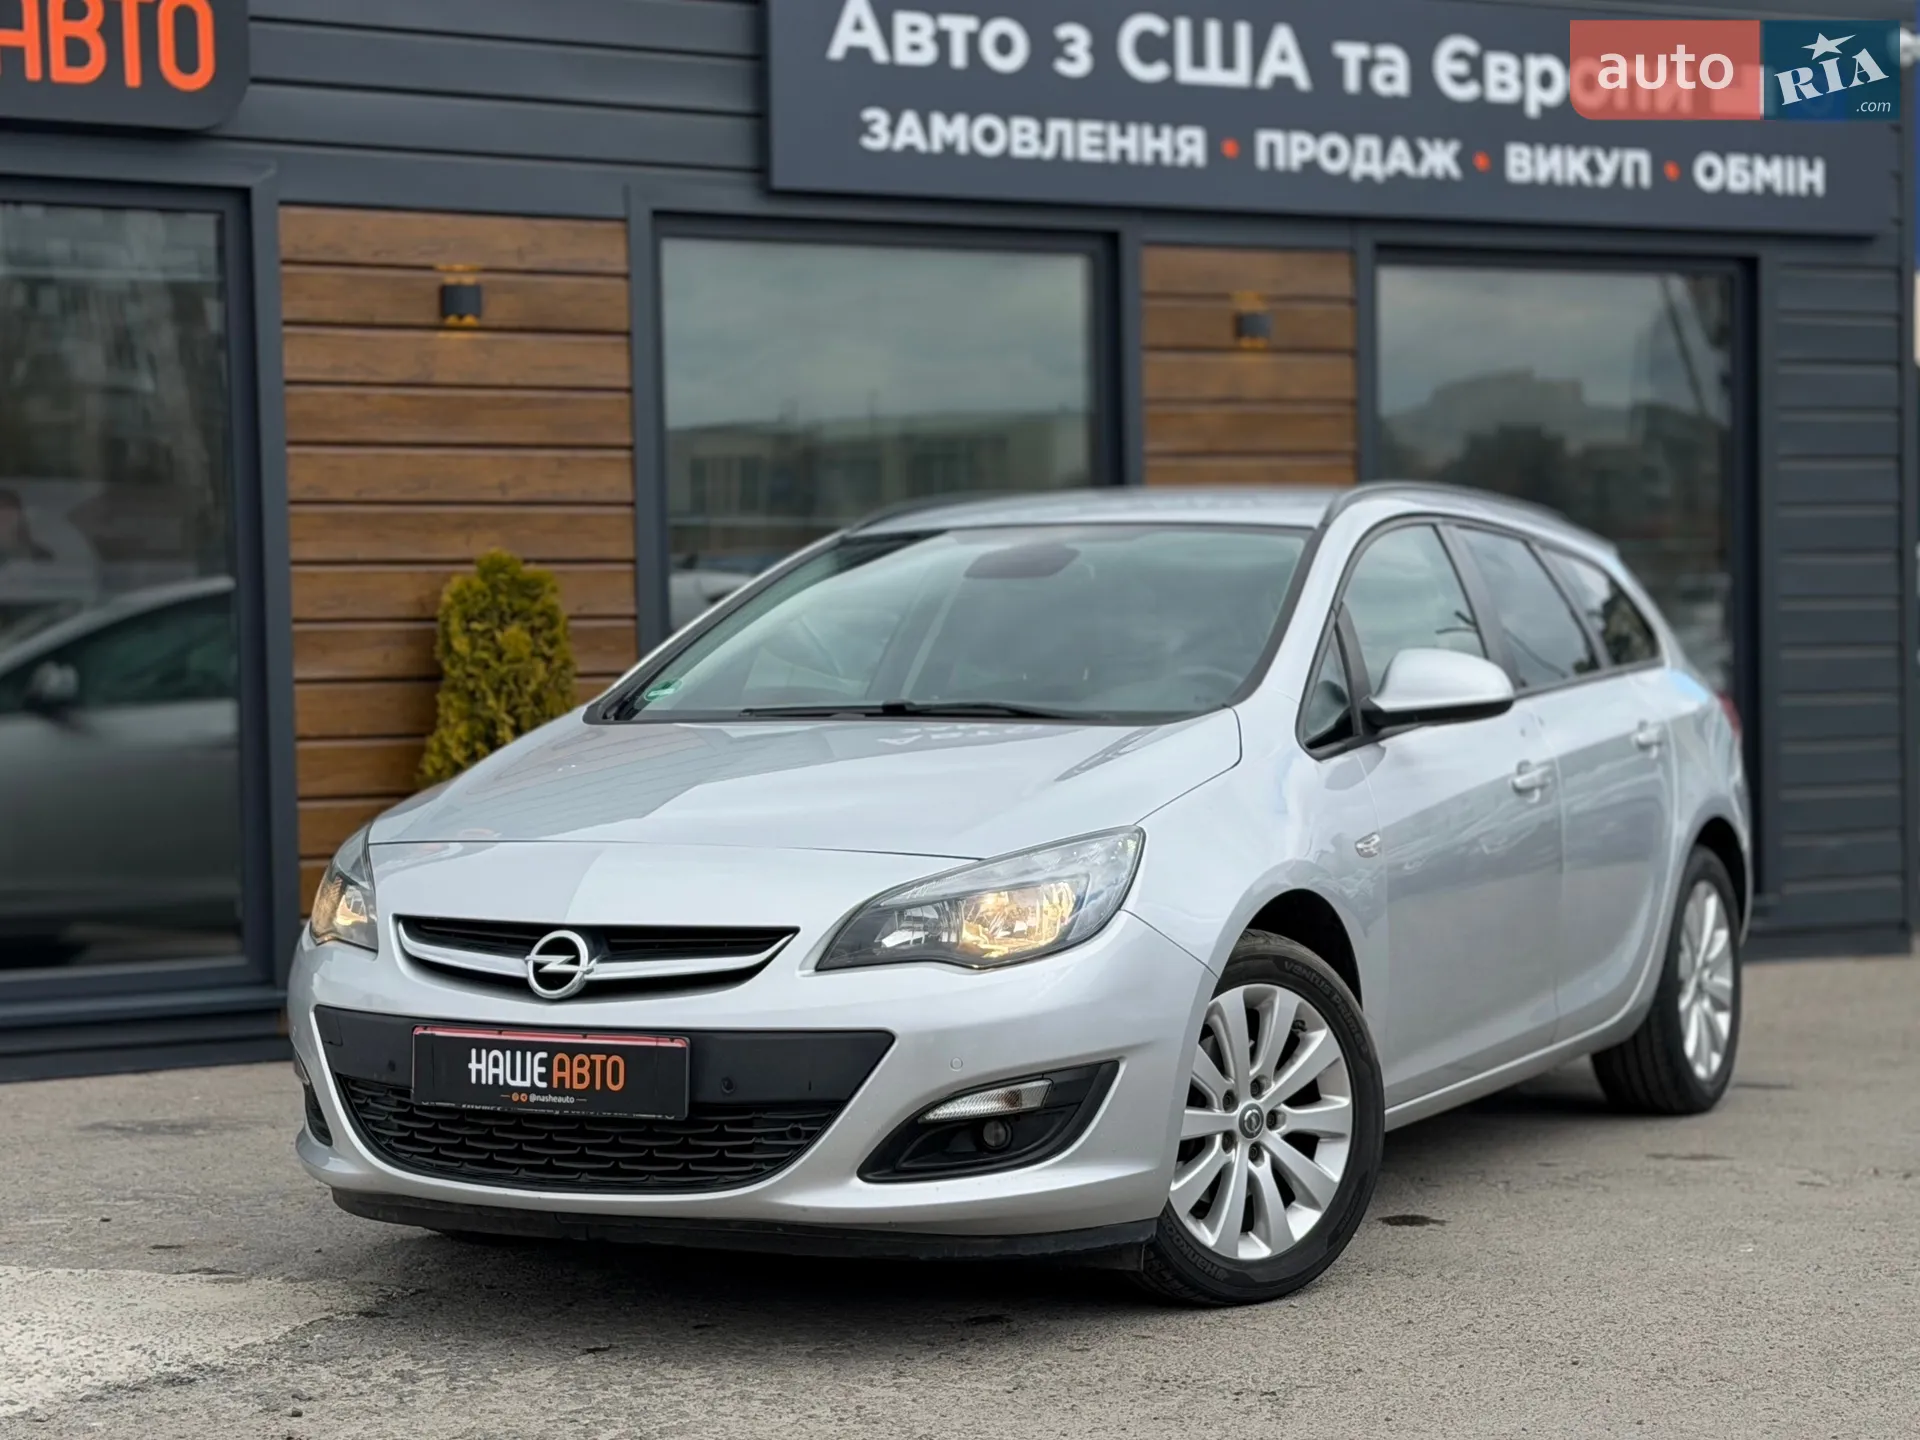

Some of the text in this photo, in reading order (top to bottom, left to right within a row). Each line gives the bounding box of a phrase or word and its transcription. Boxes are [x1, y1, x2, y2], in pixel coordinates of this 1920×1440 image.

[827, 0, 1030, 74] Авто
[1117, 12, 1312, 92] США
[1332, 41, 1410, 97] та
[860, 107, 1826, 196] ЗАМОВЛЕННЯ ПРОДАЖ ВИКУП ОБМІН
[468, 1048, 625, 1091] НАШЕ АВТО
[529, 1092, 575, 1104] @nasheauto
